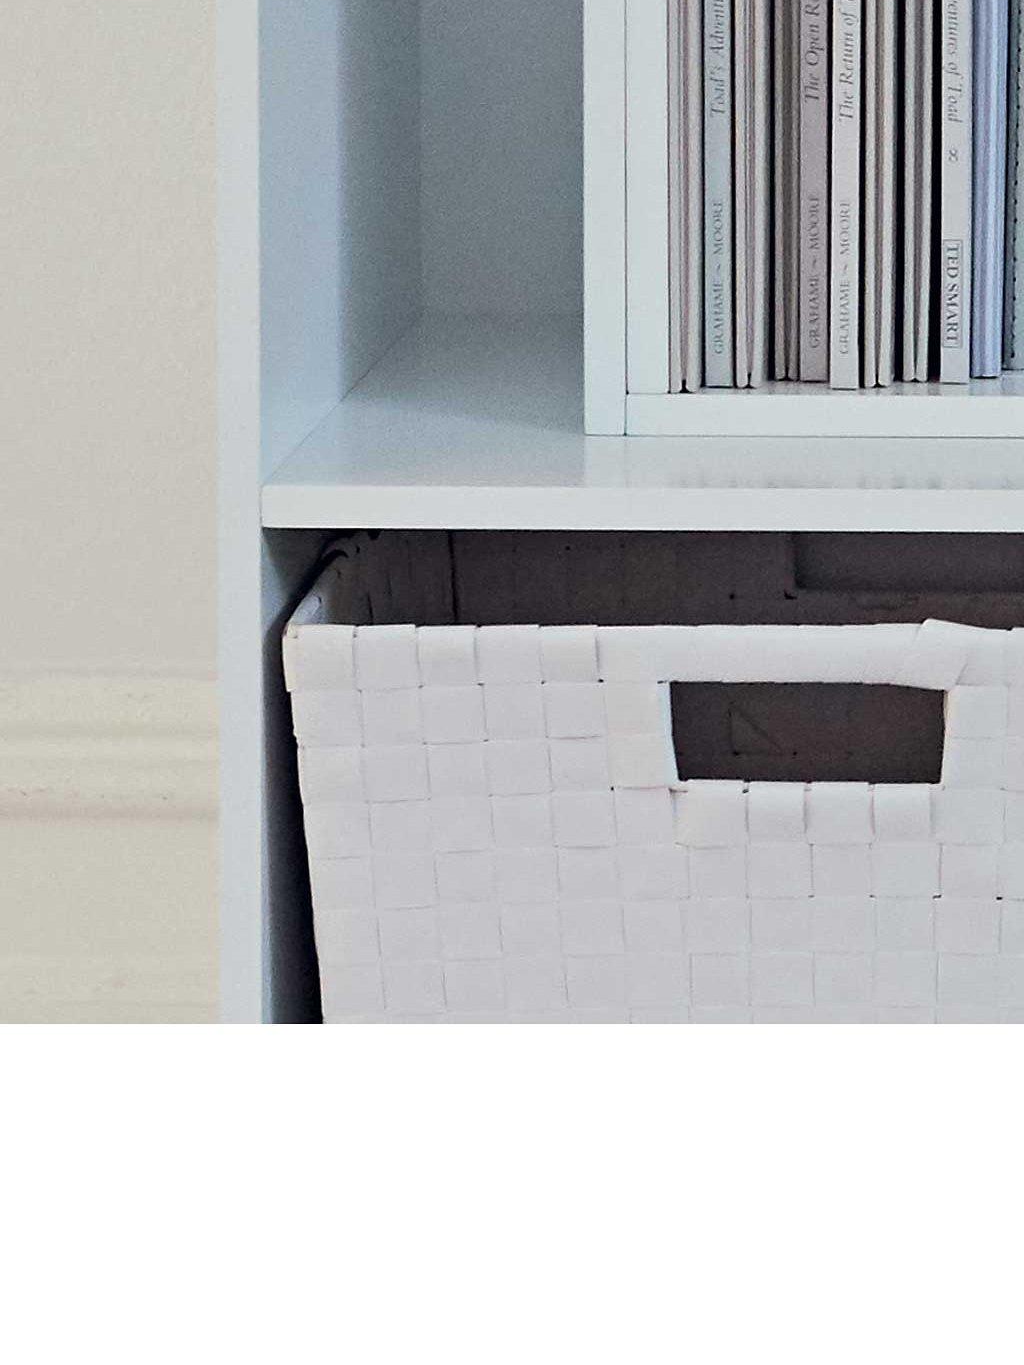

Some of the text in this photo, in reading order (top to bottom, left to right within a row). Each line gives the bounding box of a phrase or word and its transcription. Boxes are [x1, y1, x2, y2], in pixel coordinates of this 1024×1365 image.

[838, 11, 859, 26] of
[804, 25, 825, 66] Open
[838, 33, 854, 85] Return
[946, 62, 964, 76] of
[710, 65, 725, 117] Toad's
[804, 76, 820, 103] The
[838, 92, 854, 122] The
[946, 87, 963, 122] Toad
[712, 201, 724, 255] MOORE
[808, 196, 820, 250] MOORE
[839, 201, 850, 255] MOORE
[839, 281, 850, 354] GRAHAME
[945, 244, 960, 343] TED SMART
